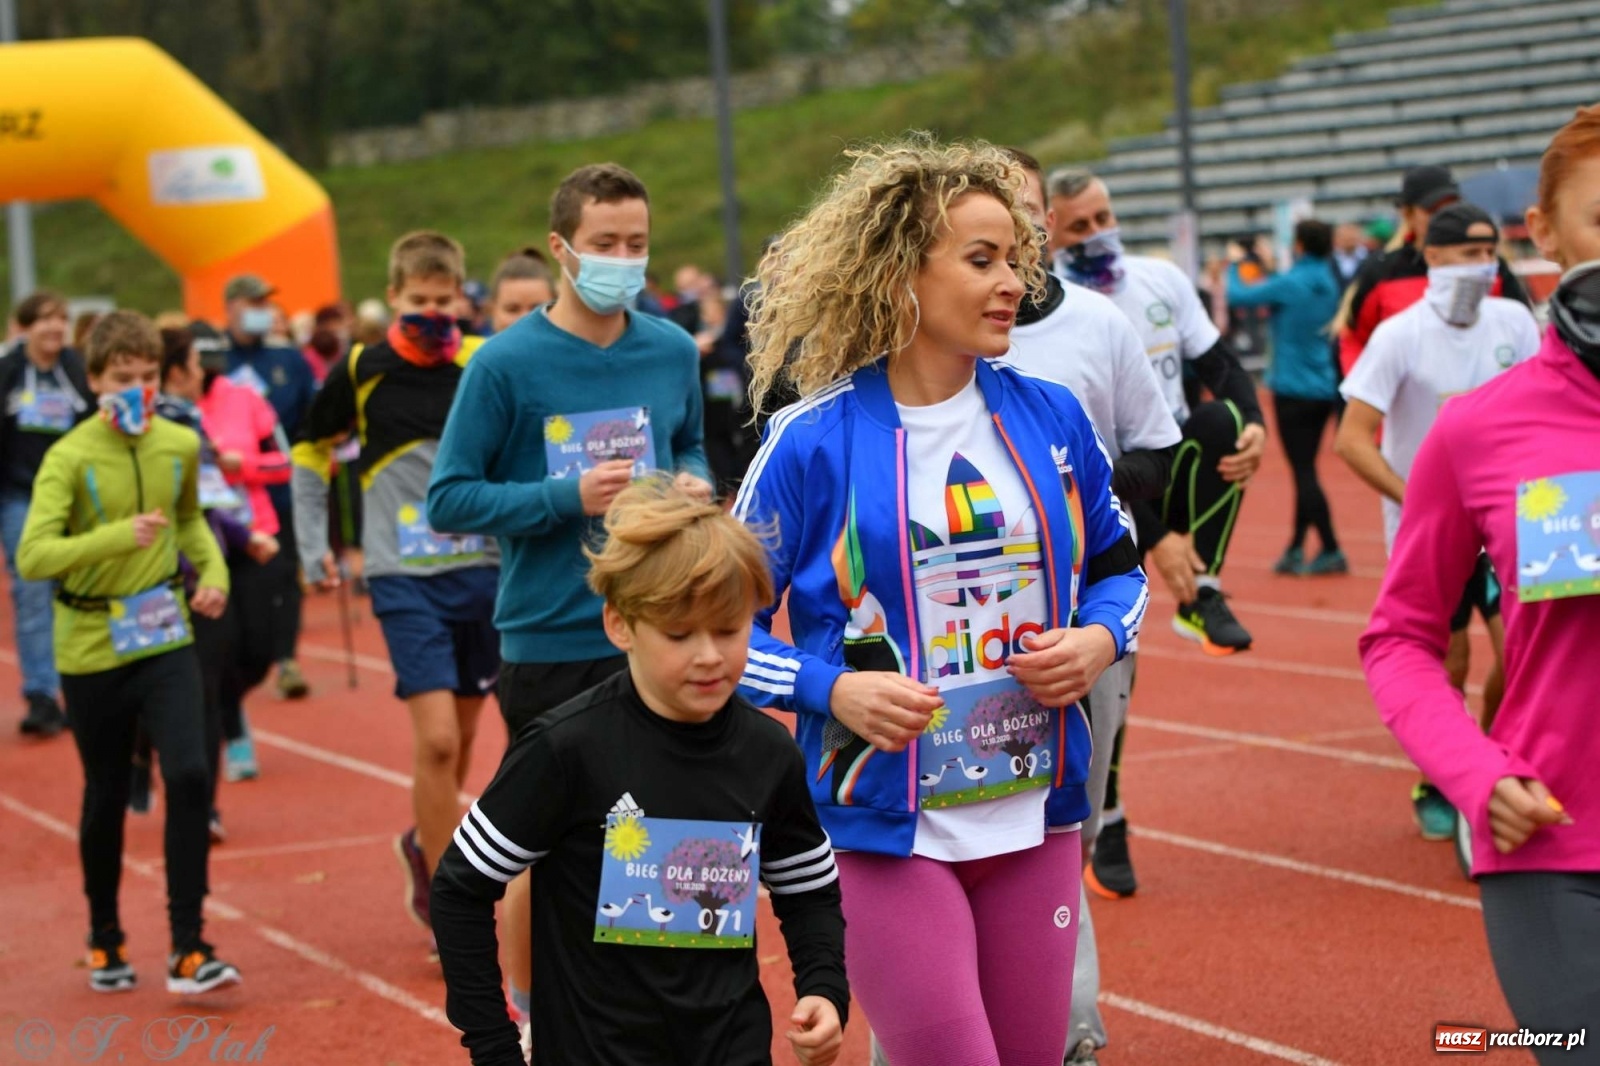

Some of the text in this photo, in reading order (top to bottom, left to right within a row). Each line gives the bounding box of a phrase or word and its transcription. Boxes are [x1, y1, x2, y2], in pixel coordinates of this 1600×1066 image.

[933, 729, 963, 747] BIEG
[971, 722, 996, 740] DLA
[1009, 749, 1052, 778] 093
[625, 862, 658, 879] BIEG
[667, 865, 693, 881] DLA
[698, 908, 742, 937] 071
